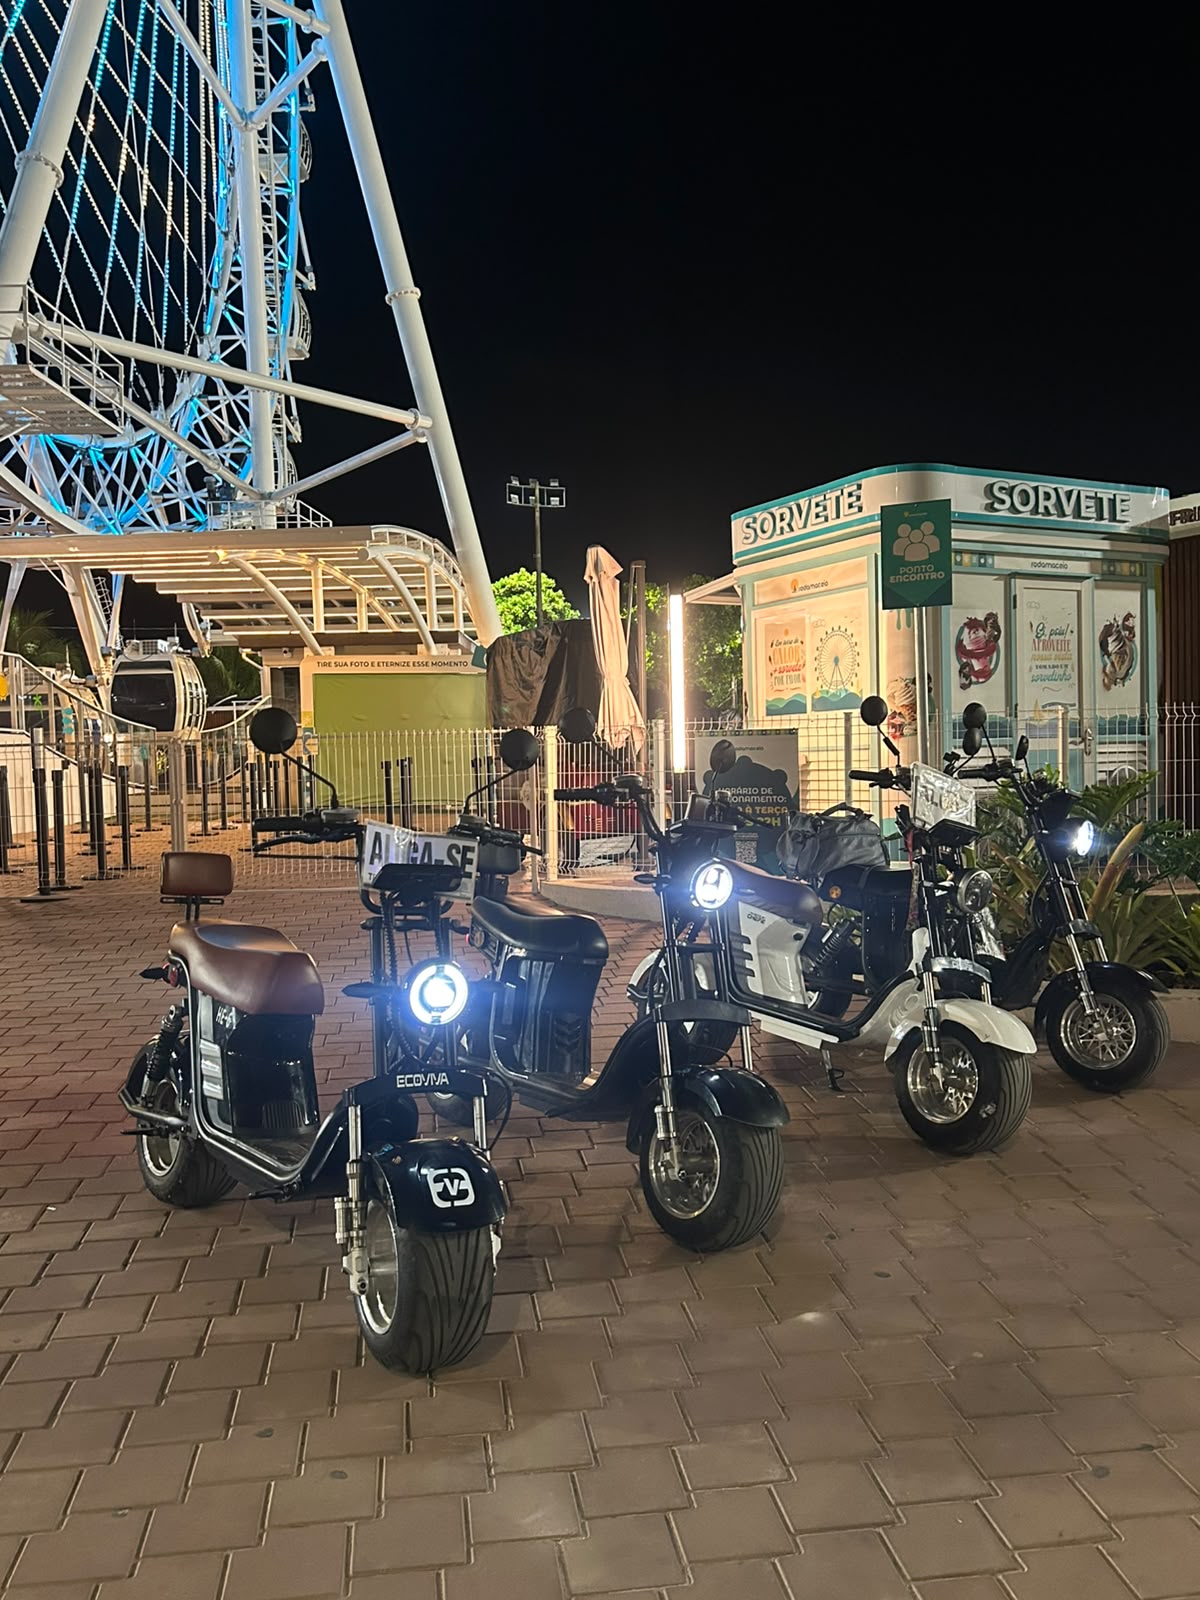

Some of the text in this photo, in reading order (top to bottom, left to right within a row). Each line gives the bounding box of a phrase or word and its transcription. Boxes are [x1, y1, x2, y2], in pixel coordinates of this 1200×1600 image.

[985, 480, 1131, 523] SORVETE
[742, 483, 863, 545] SORVETE
[900, 564, 934, 574] PONTO
[889, 571, 945, 583] ENCONTRO
[1032, 639, 1072, 652] APROVEITE
[761, 787, 773, 795] DE
[396, 1072, 449, 1088] ECOVIVA
